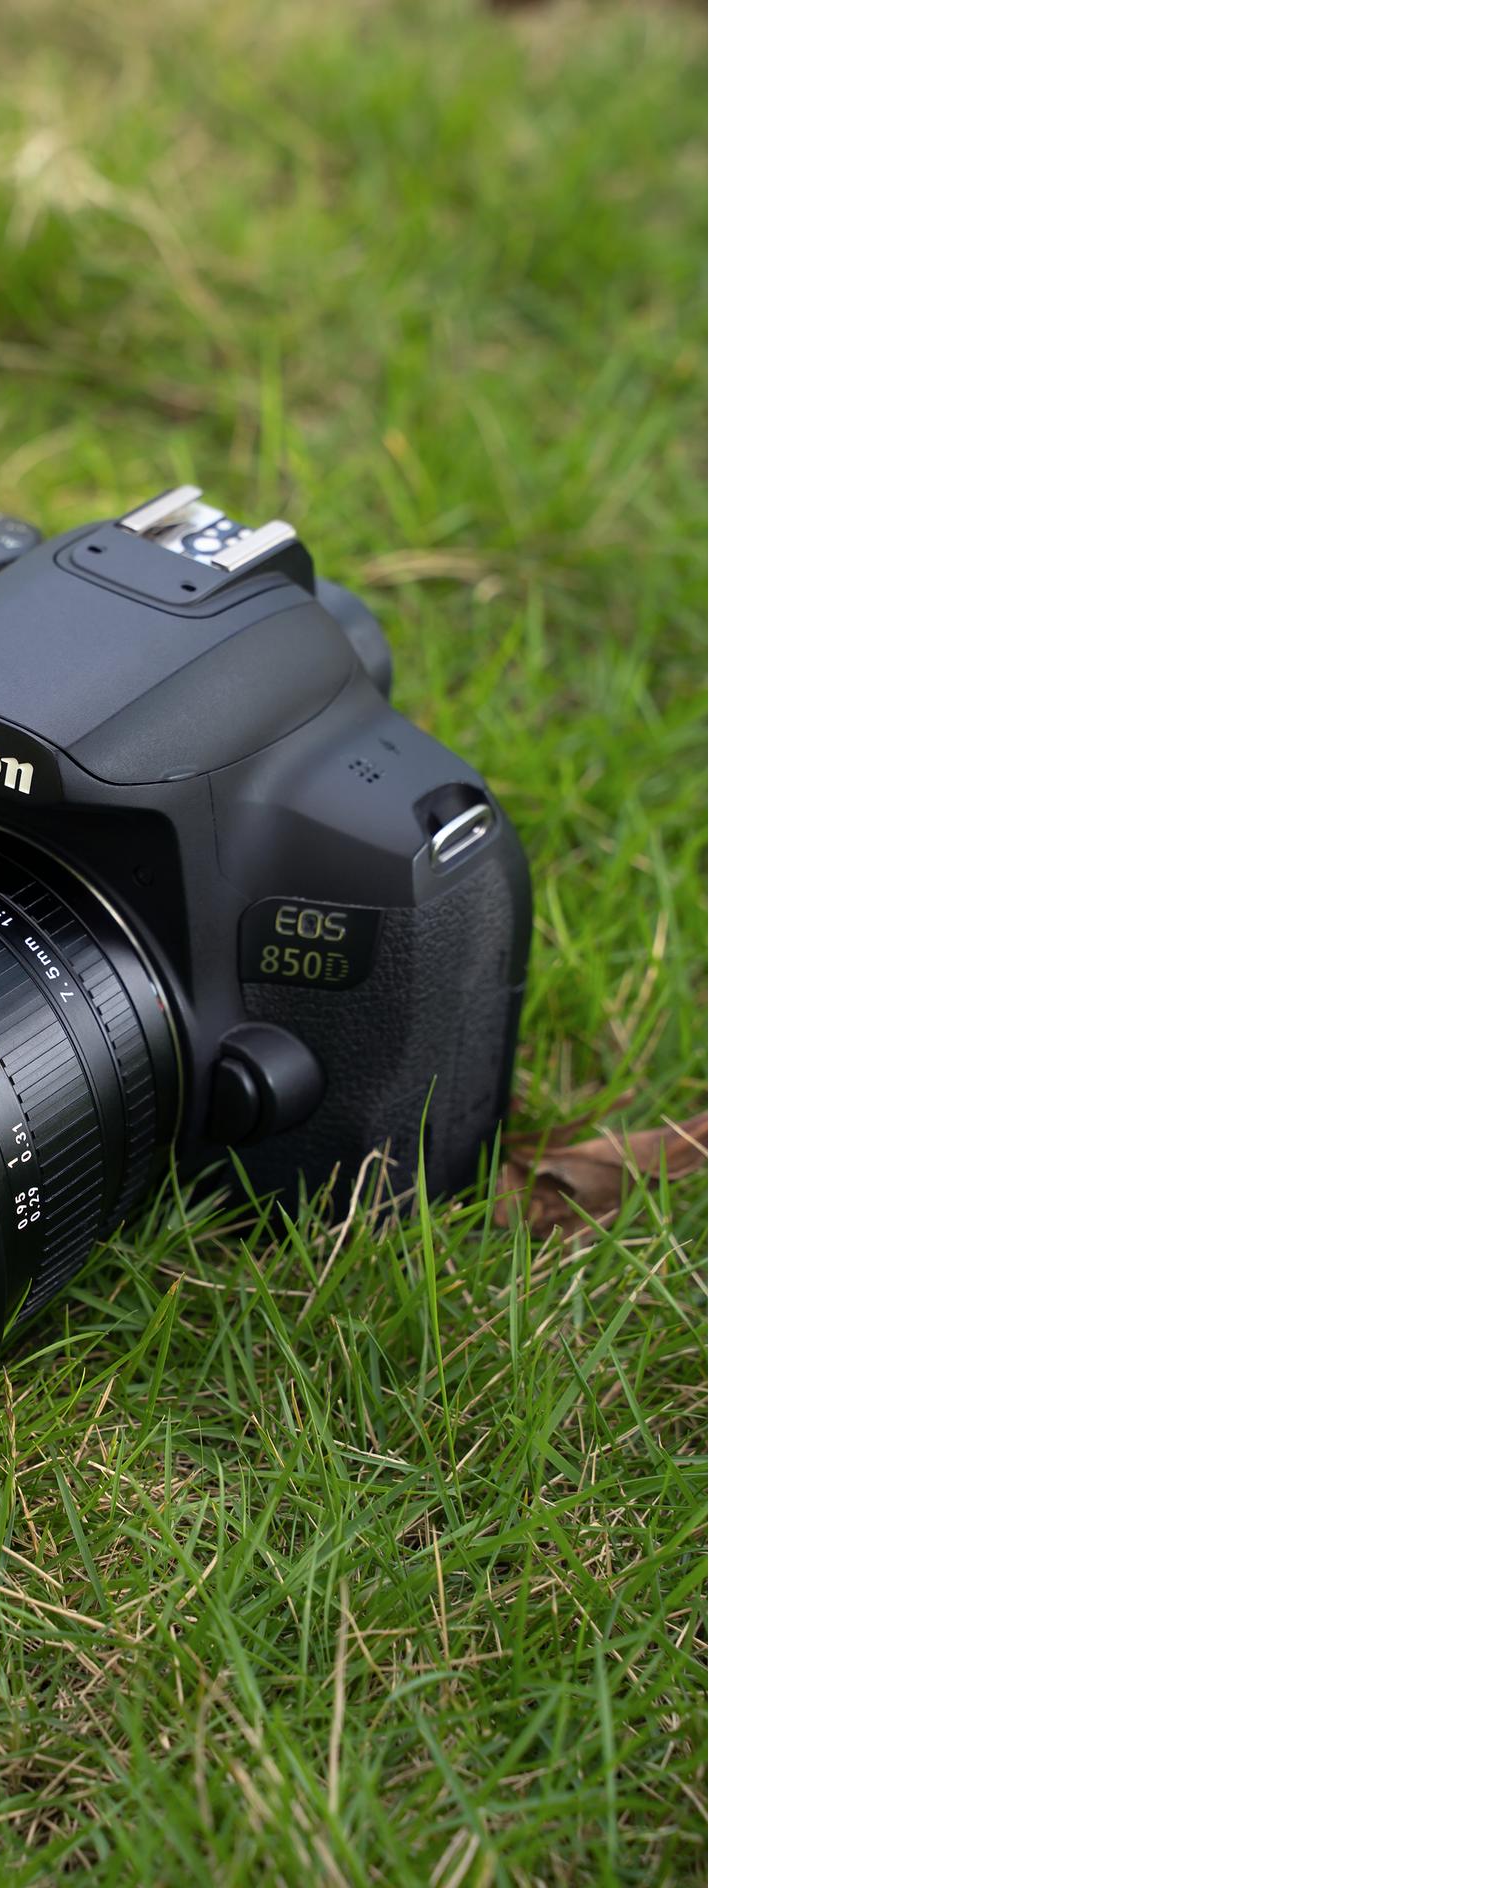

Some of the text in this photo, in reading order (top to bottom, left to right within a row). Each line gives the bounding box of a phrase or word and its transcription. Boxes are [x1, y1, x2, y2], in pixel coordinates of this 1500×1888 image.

[275, 905, 348, 941] EOS
[259, 945, 349, 982] 850D
[11, 1122, 32, 1163] 0.31
[7, 1157, 19, 1169] 1
[14, 1192, 28, 1230] 0.95
[27, 1187, 41, 1222] 0.29
